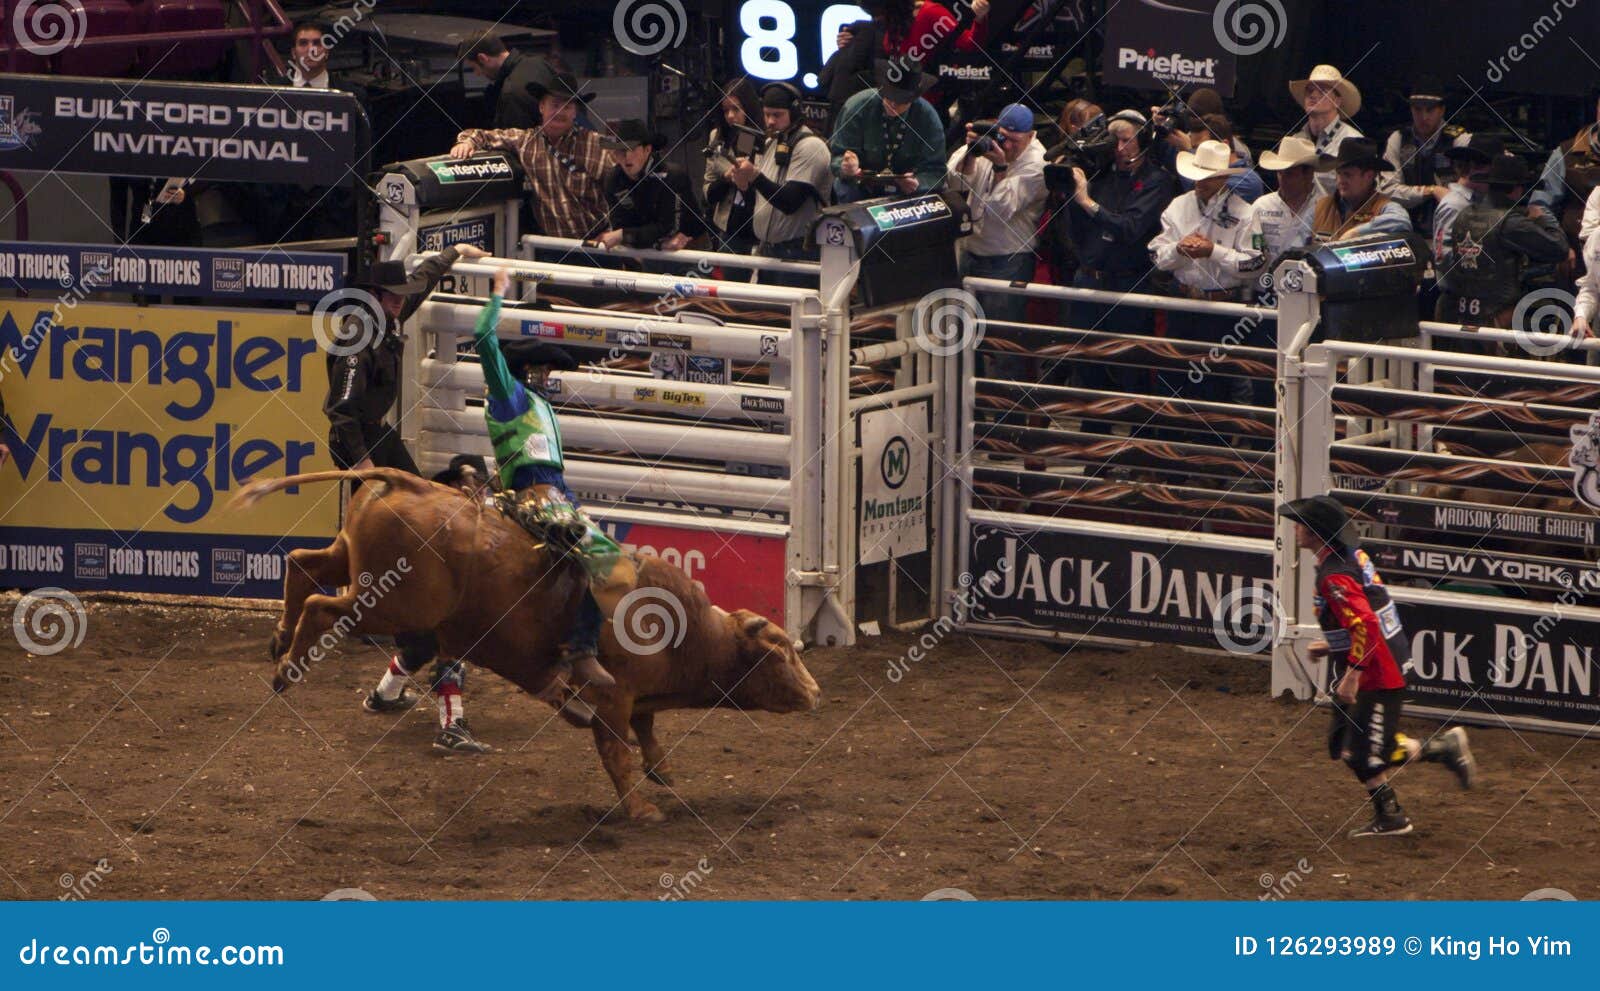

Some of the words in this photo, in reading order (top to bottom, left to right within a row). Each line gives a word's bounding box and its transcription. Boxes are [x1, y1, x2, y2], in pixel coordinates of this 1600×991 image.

[1119, 48, 1219, 78] Priefert
[55, 97, 140, 121] BUILT
[146, 102, 232, 126] FORD
[237, 108, 349, 131] TOUGH
[93, 132, 309, 162] INVITATIONAL
[438, 161, 509, 178] enterprise
[445, 223, 485, 243] TRAILER
[17, 254, 70, 281] TRUCKS
[113, 257, 146, 282] FORD
[147, 259, 201, 285] TRUCKS
[245, 263, 280, 288] FORD
[281, 264, 334, 290] TRUCKS
[0, 310, 317, 421] Wrangler
[0, 414, 315, 524] Wrangler
[864, 496, 922, 521] Montana
[1434, 507, 1491, 532] MADISON
[1496, 515, 1541, 536] SQUARE
[1545, 523, 1595, 545] GARDEN
[10, 545, 63, 572] TRUCKS
[109, 549, 144, 575] FORD
[145, 550, 200, 578] TRUCKS
[246, 554, 282, 580] FORD
[1402, 549, 1476, 574] NEW
[986, 537, 1110, 610] JACK
[1402, 630, 1473, 684] CK
